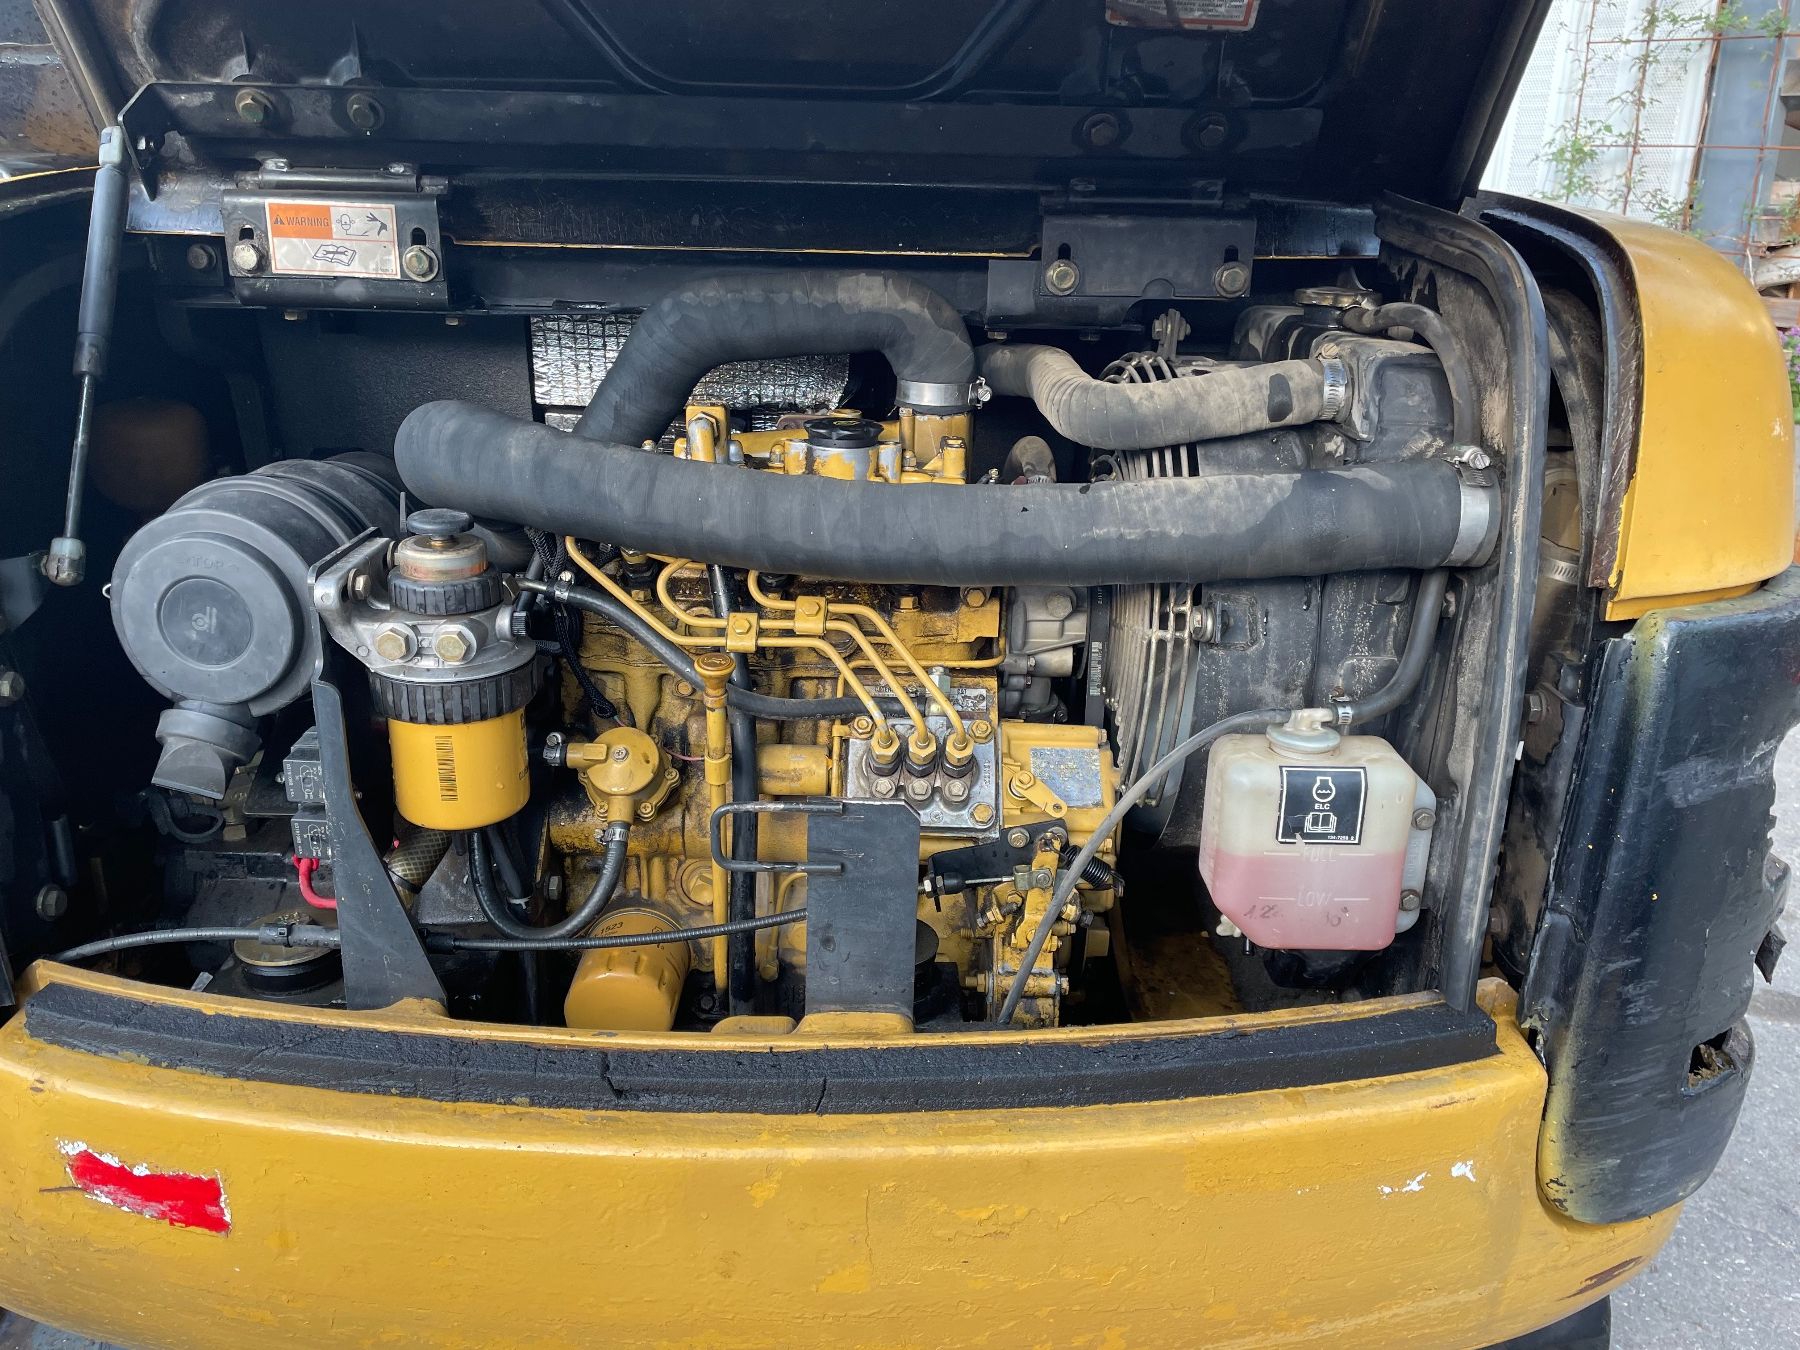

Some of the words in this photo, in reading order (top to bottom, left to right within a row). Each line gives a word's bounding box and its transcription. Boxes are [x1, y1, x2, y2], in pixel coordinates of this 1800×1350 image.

[286, 216, 329, 227] WARNING
[1303, 847, 1337, 862] FULL
[1297, 890, 1332, 907] LOW
